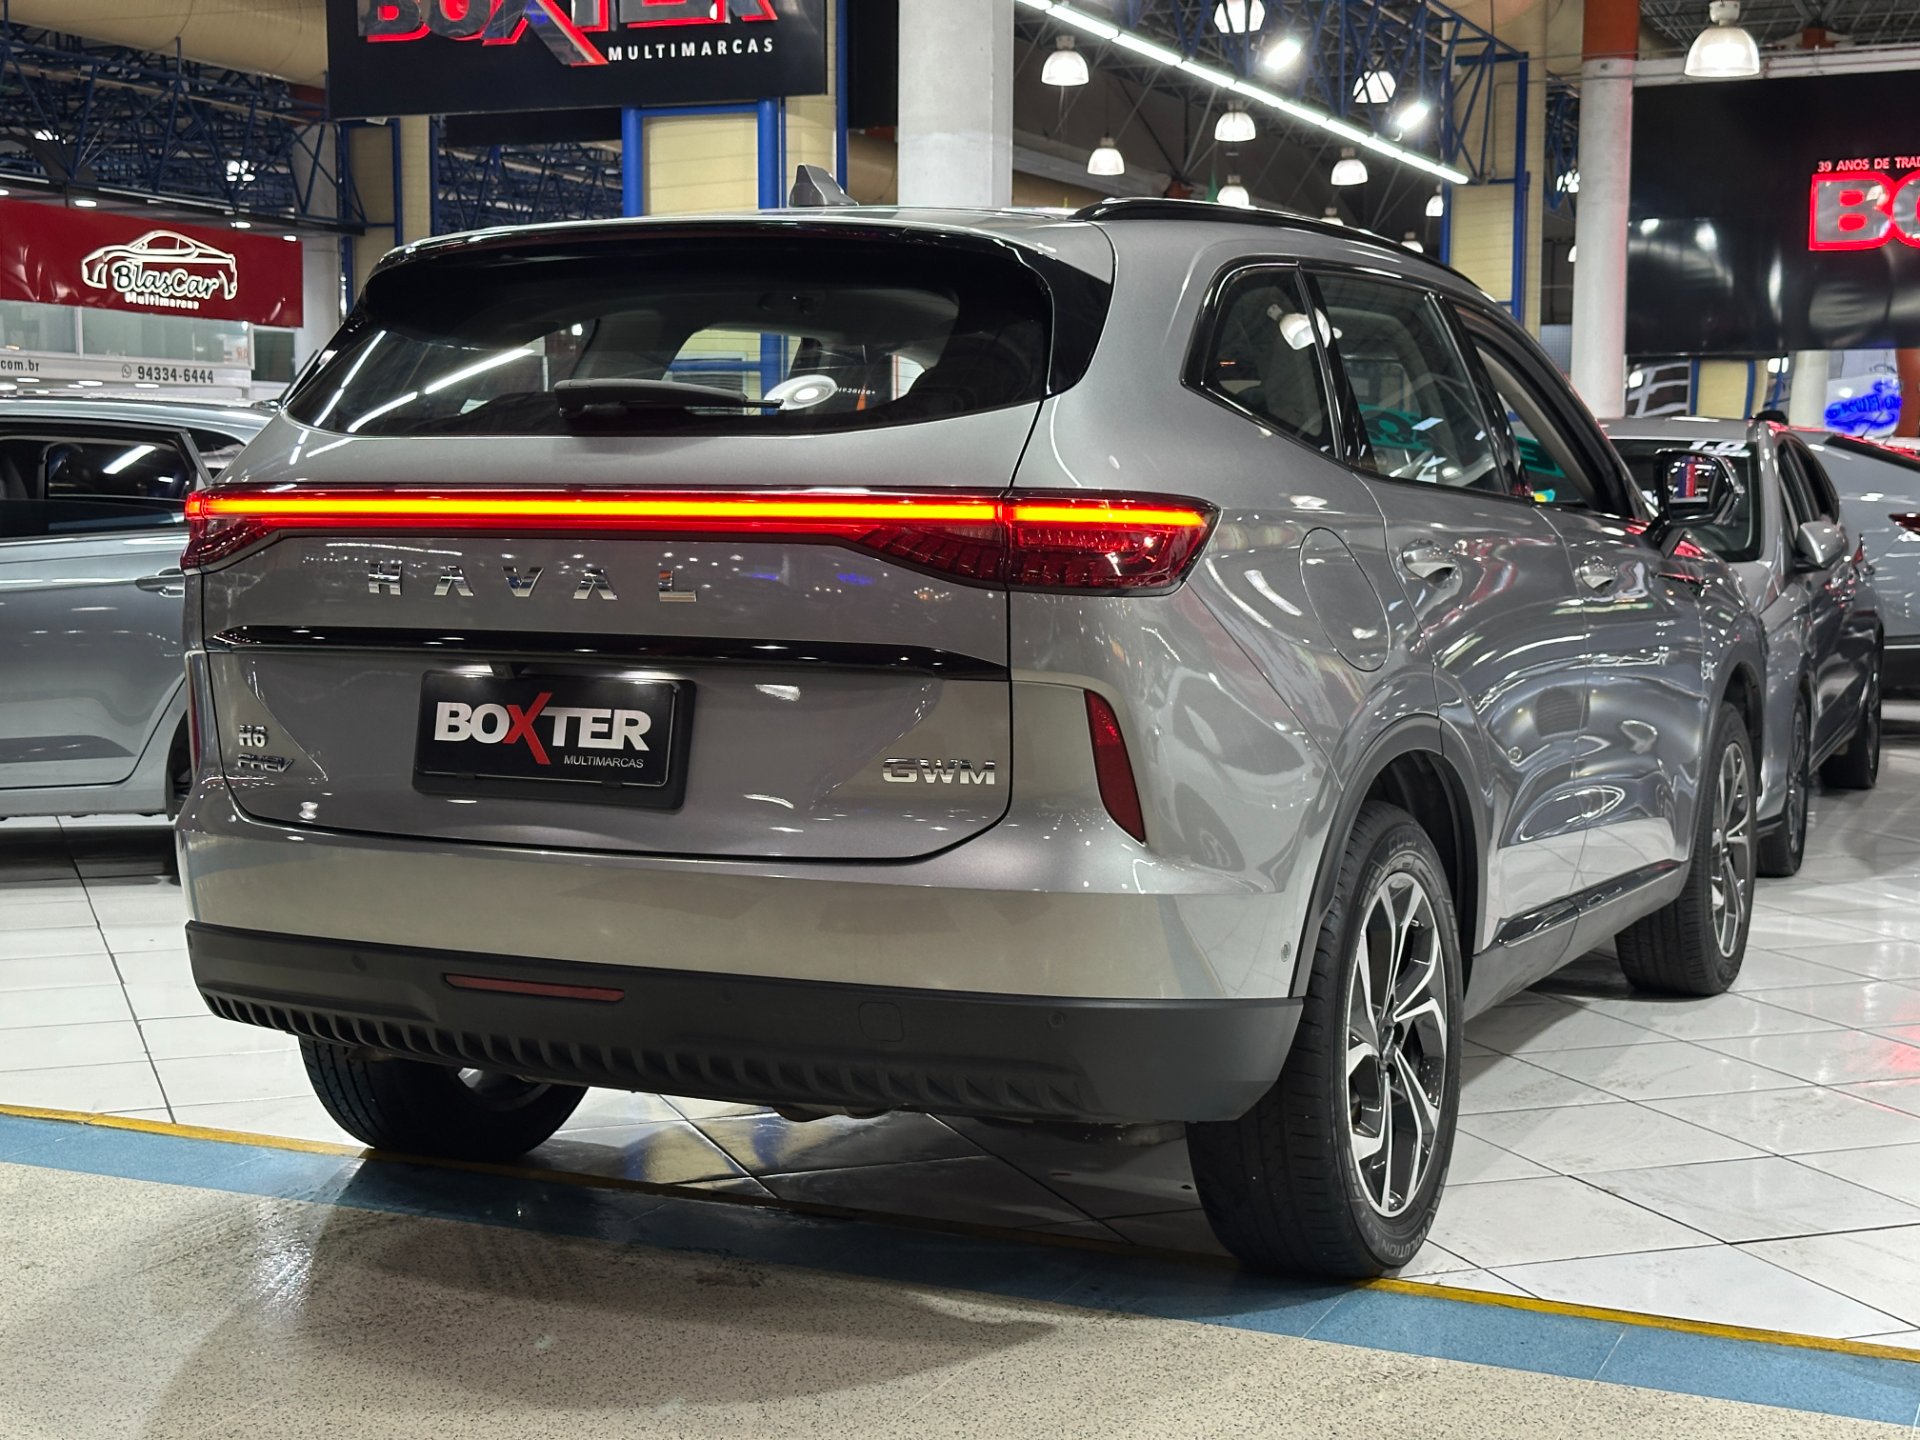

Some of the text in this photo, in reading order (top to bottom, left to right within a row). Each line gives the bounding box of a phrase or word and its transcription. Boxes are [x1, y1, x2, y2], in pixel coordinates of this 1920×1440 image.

[608, 37, 774, 61] MULTIMARCAS
[1817, 160, 1832, 172] 39
[1836, 158, 1870, 171] ANOS
[1873, 157, 1890, 169] DE
[113, 260, 219, 299] BlasCar
[138, 365, 214, 383] 94334-6444
[368, 563, 697, 602] HAVAL
[238, 724, 267, 748] H6
[434, 692, 651, 765] BOXTER
[563, 755, 644, 769] MULTIMARCAS
[883, 758, 996, 785] GWM
